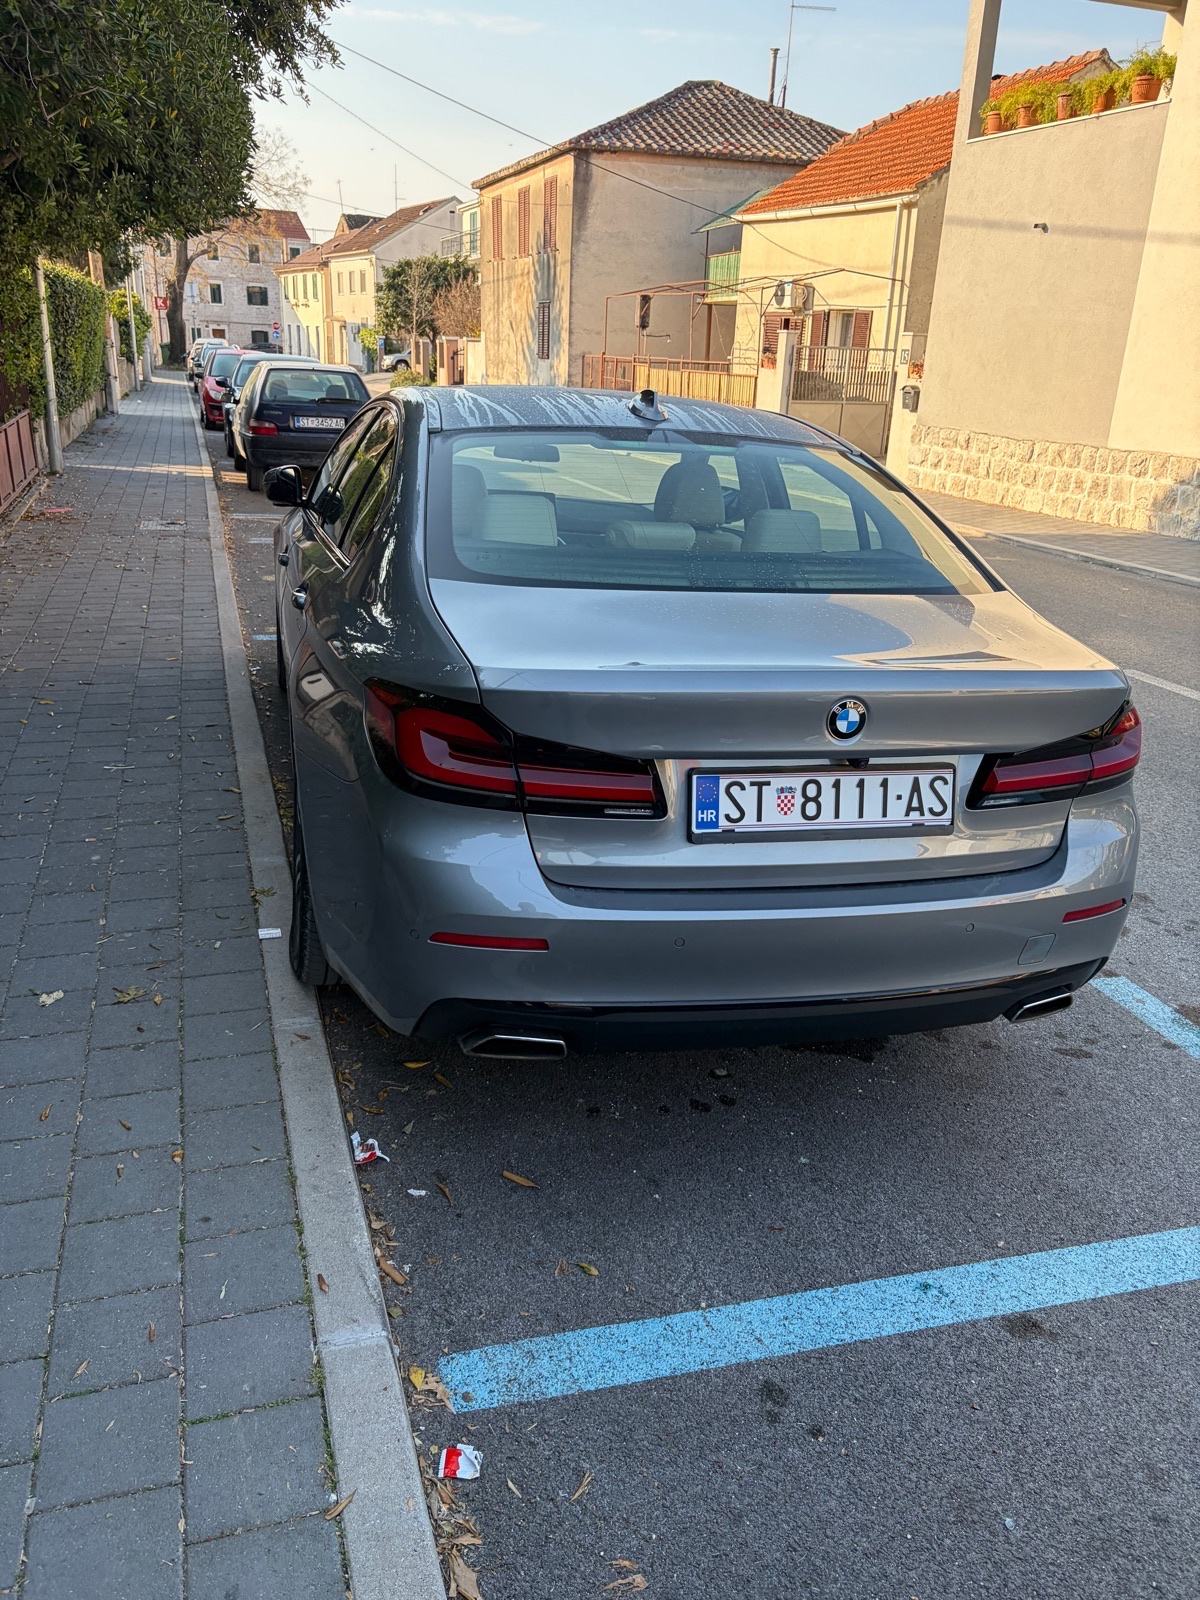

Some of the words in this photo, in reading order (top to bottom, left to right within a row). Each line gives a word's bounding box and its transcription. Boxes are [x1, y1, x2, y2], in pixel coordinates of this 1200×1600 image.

[301, 417, 310, 427] ST
[834, 701, 865, 714] BMW
[724, 780, 771, 824] ST
[698, 809, 717, 822] HR
